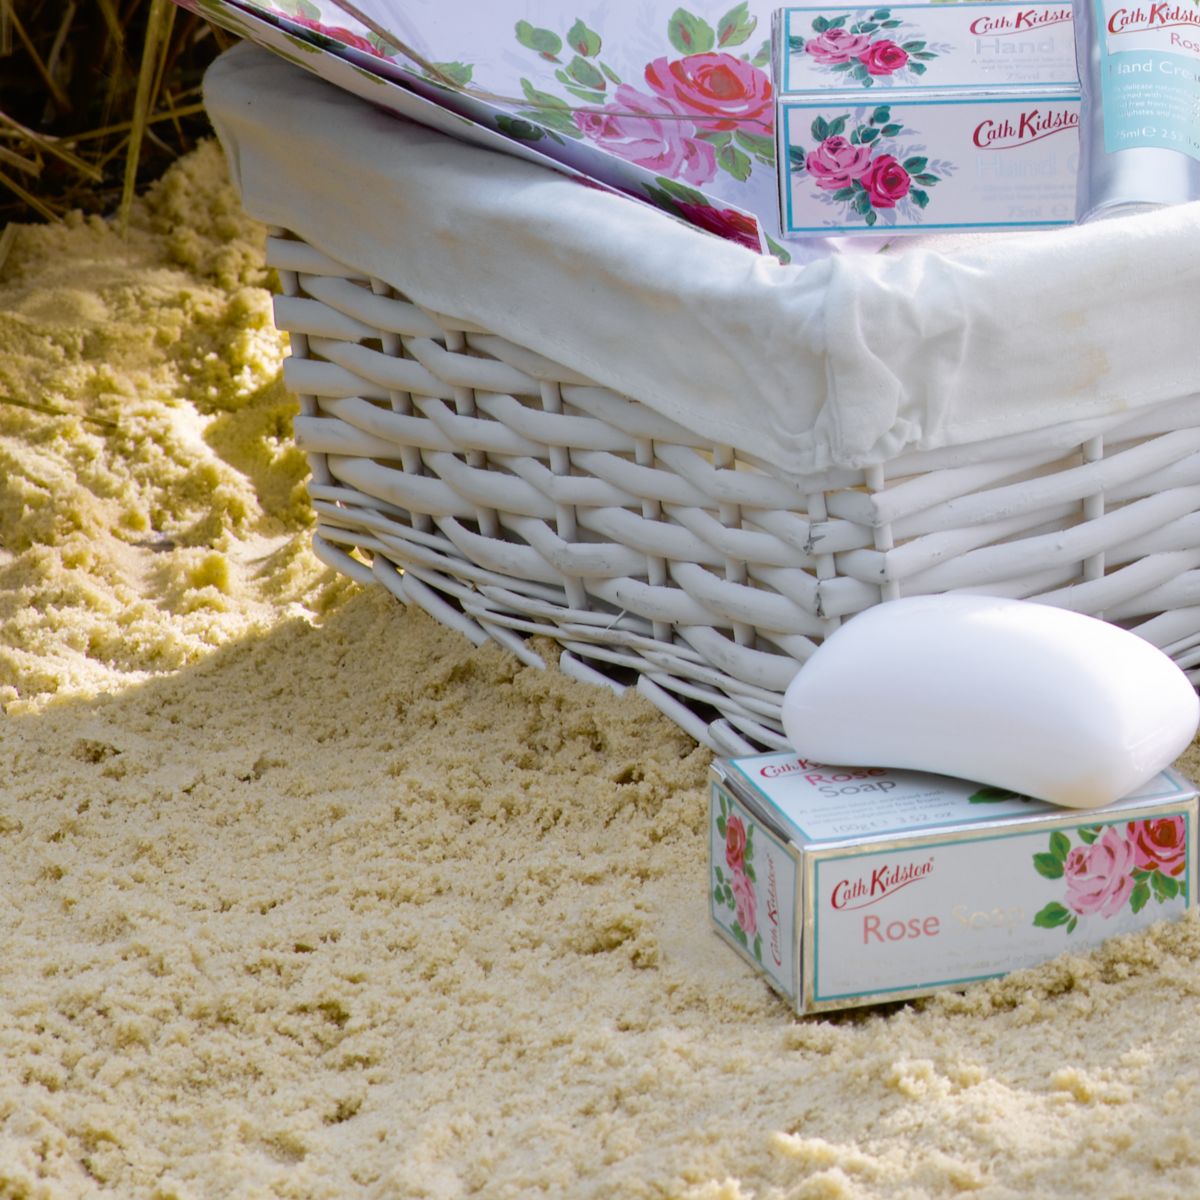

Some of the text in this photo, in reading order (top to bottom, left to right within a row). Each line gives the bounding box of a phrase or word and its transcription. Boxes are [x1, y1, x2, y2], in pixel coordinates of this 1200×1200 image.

[969, 16, 1013, 36] Cath
[1108, 8, 1147, 33] Cath
[976, 37, 1055, 55] Hand
[972, 109, 1079, 148] Cath Kidsto
[976, 153, 1056, 177] Hand
[760, 764, 798, 778] Cath
[805, 769, 888, 786] Rose
[818, 780, 896, 798] Soap
[831, 861, 935, 910] Cath Kidston
[863, 903, 1025, 945] Rose Soap
